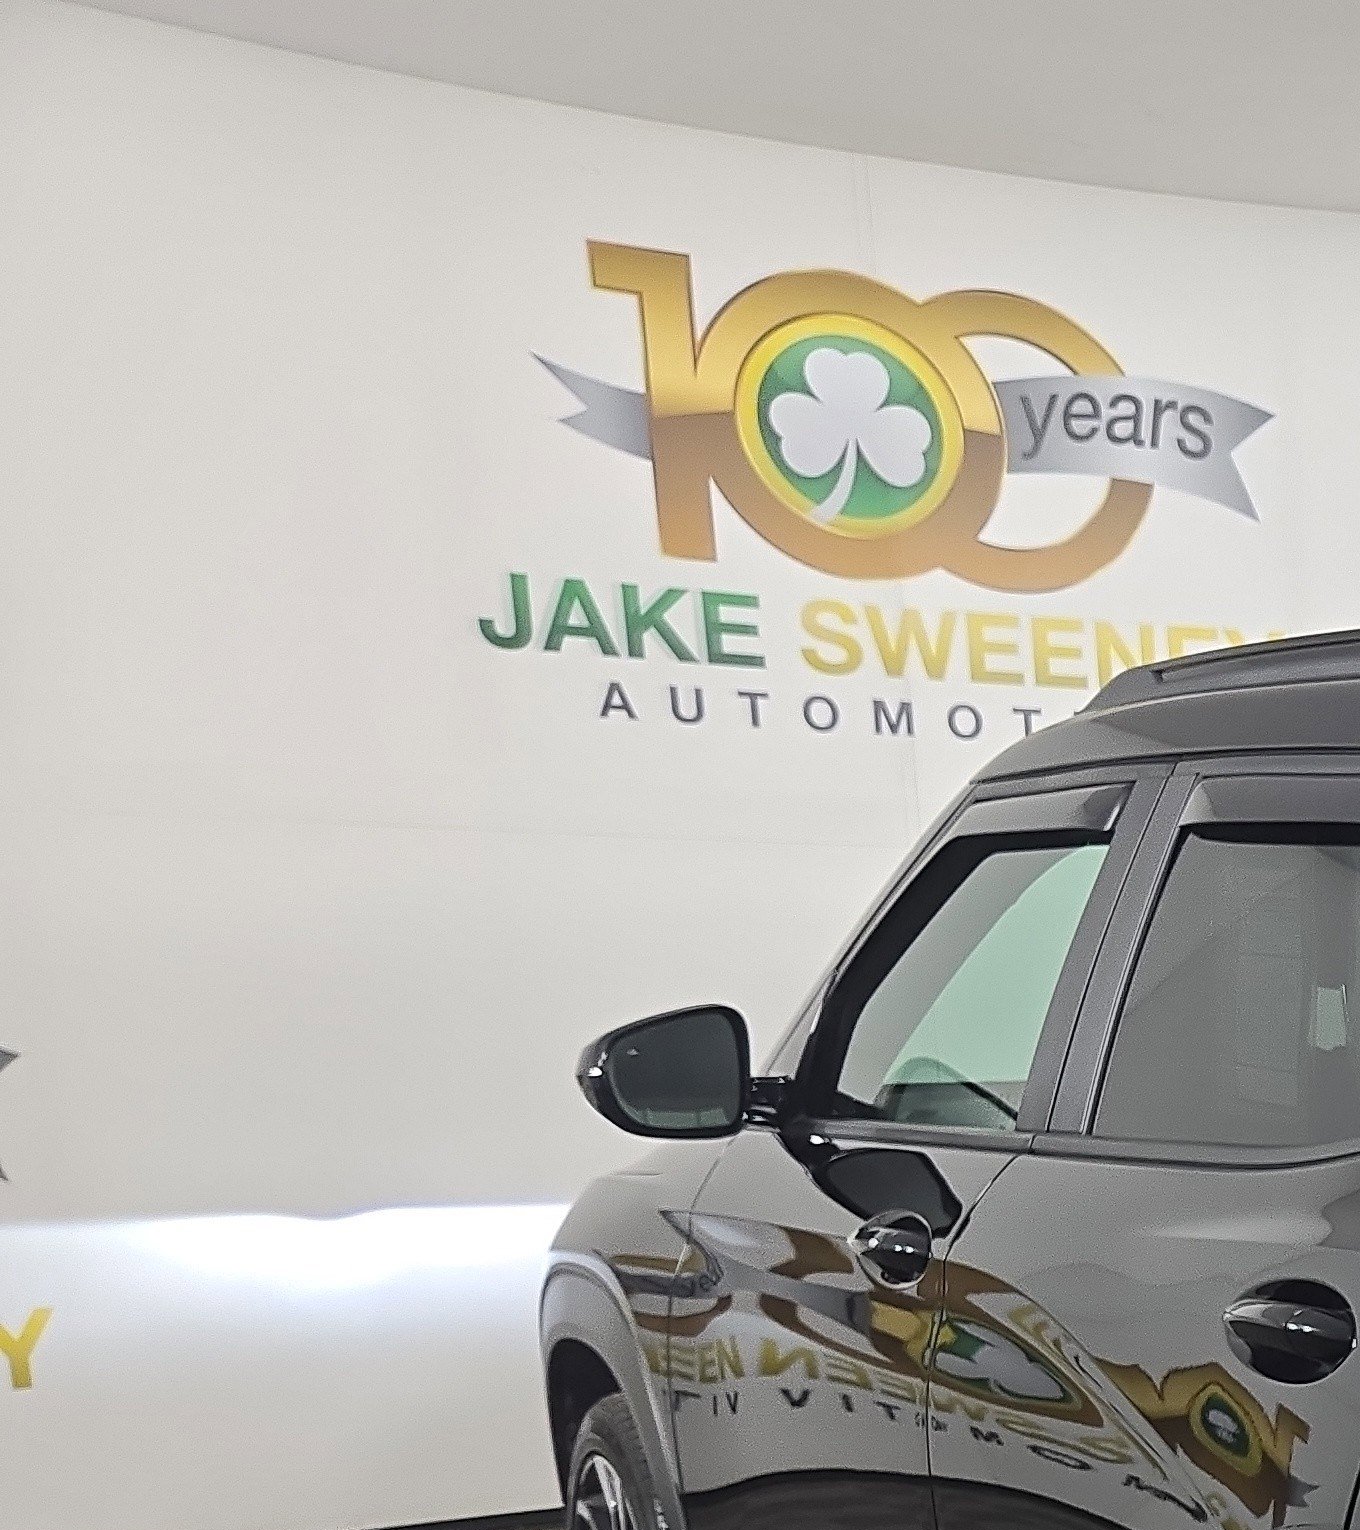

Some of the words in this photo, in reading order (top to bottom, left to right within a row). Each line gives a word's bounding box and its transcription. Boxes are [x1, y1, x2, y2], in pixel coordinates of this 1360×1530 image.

[586, 239, 1155, 593] 100
[1017, 383, 1216, 460] years
[477, 571, 768, 670] JAKE
[799, 597, 1287, 692] SWEEN
[599, 680, 1042, 741] AUTOMOT
